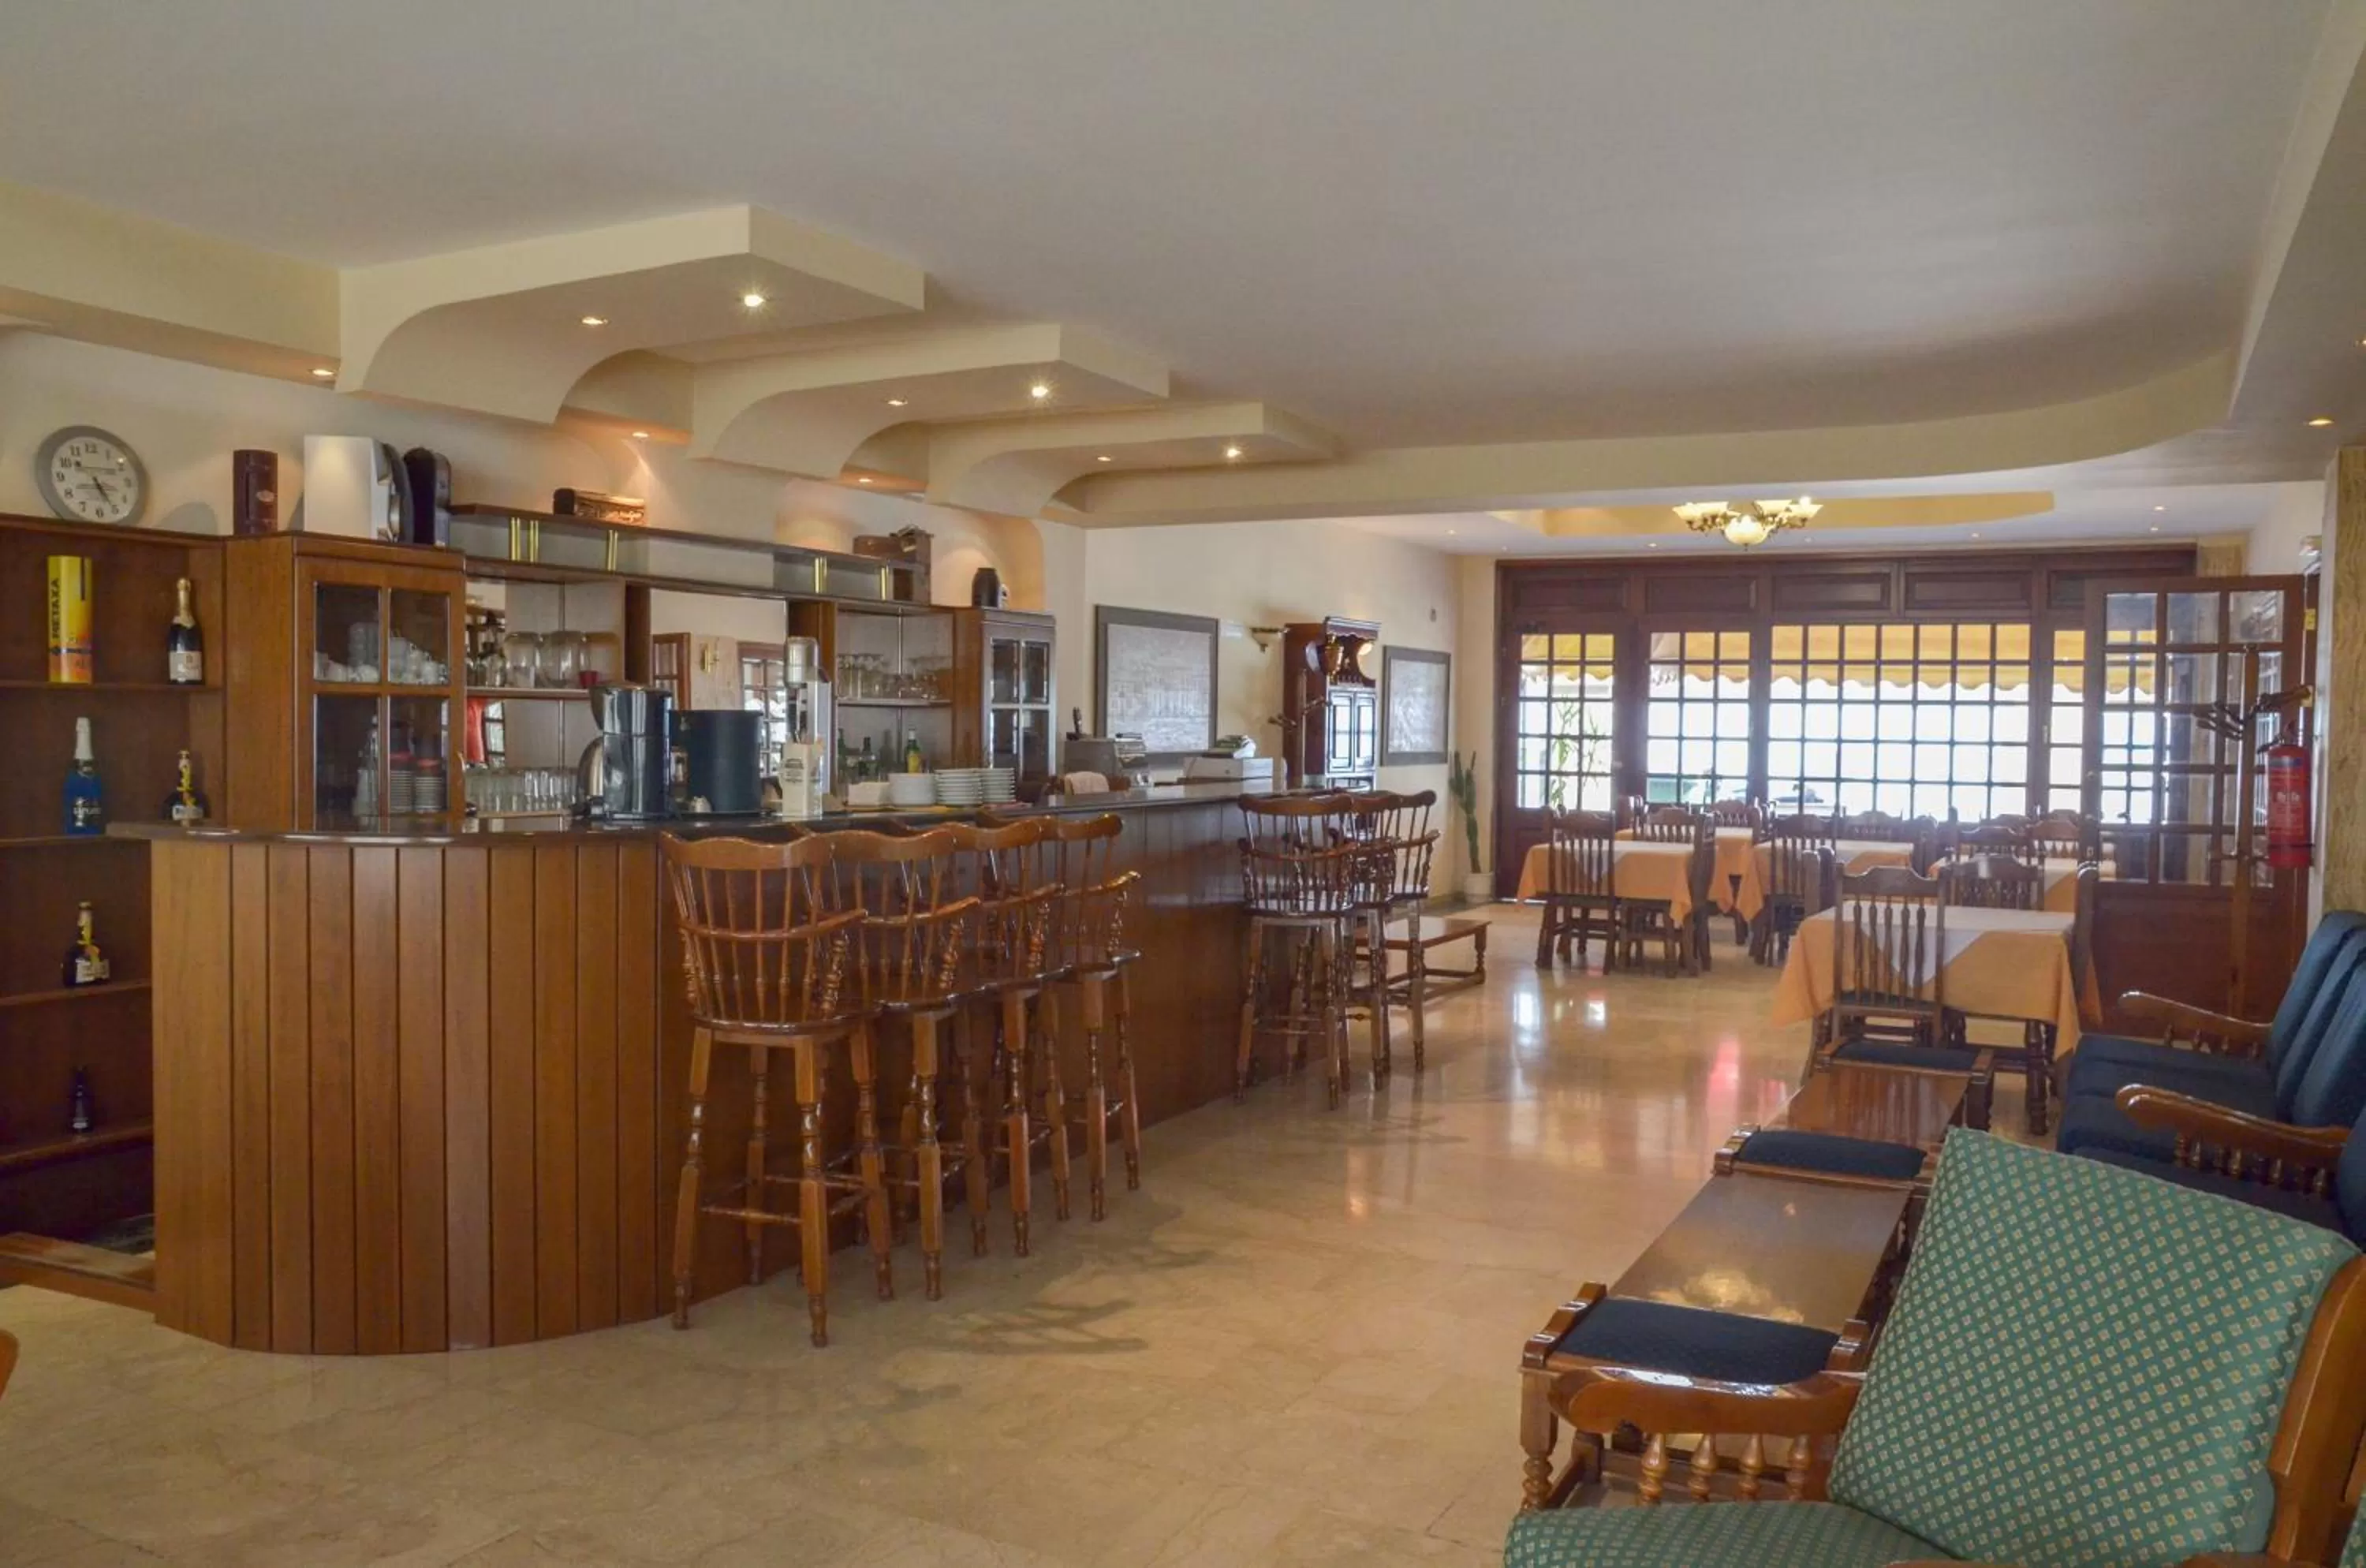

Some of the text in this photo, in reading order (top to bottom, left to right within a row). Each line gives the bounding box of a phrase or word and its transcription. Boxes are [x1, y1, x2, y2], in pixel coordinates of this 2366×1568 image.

[70, 444, 80, 456] 11
[84, 442, 98, 454] 12
[60, 457, 72, 468] 10
[50, 577, 61, 639] METAXA
